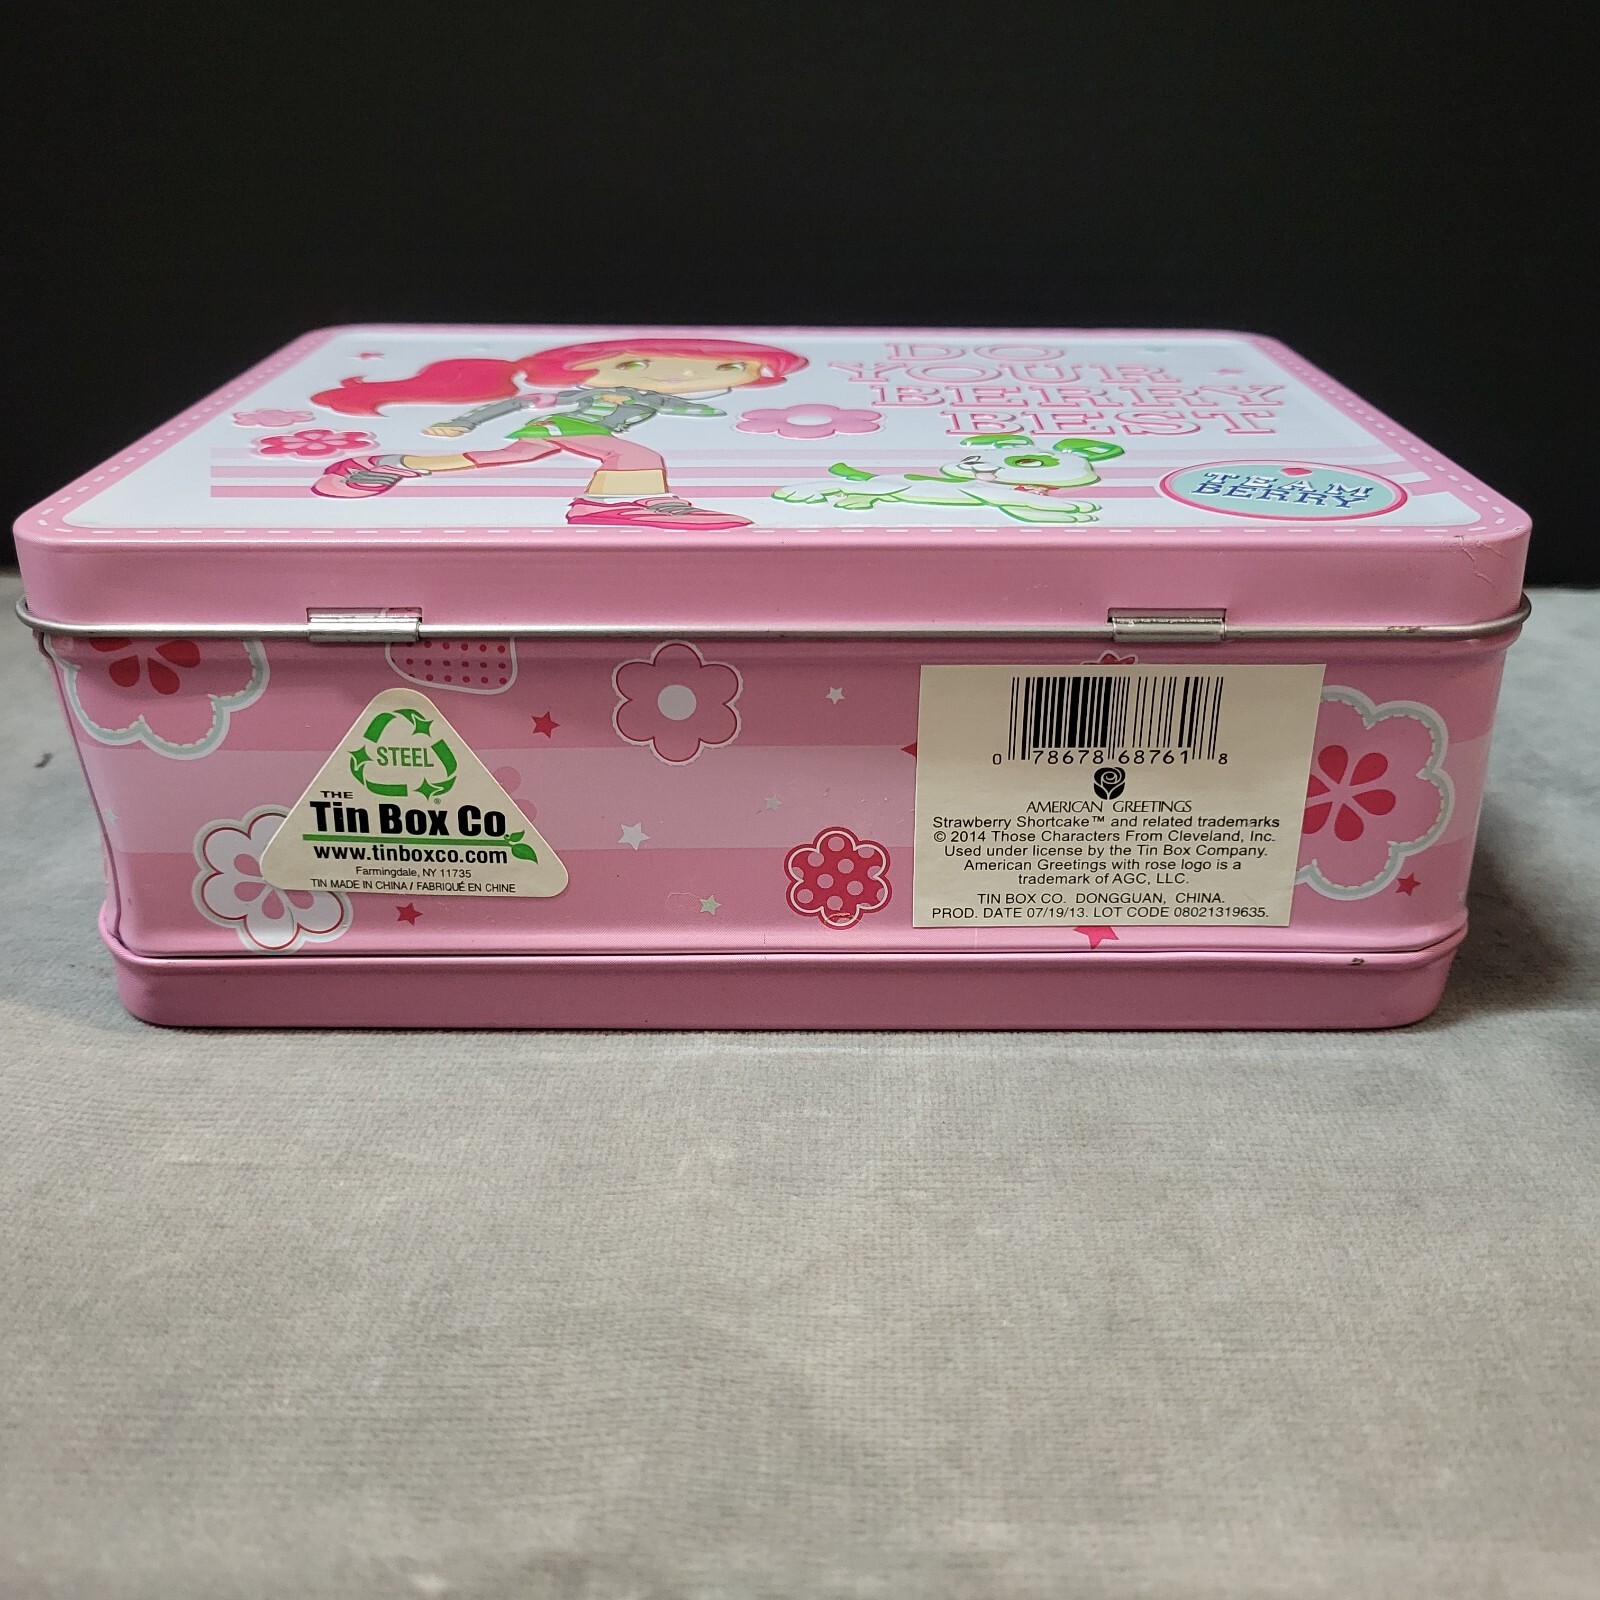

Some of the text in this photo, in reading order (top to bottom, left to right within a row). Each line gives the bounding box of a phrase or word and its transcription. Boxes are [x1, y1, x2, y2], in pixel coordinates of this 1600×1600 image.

[884, 343, 1067, 361] DO
[827, 362, 1182, 383] YOUR
[870, 385, 1286, 408] BERRY
[941, 410, 1278, 436] BEST
[1204, 472, 1374, 498] TEAM
[1191, 483, 1366, 508] BERRY
[376, 746, 434, 768] STEEL
[992, 749, 1228, 765] 0 78678 68761 8
[320, 790, 354, 799] THE
[1026, 800, 1193, 813] AMERICAN GREETINGS
[310, 801, 370, 834] Tin
[379, 803, 448, 837] Box
[933, 816, 1012, 830] Strawberry
[1110, 816, 1138, 828] and
[1142, 816, 1193, 828] related
[1198, 816, 1280, 828] trademarks
[950, 831, 987, 843] 2014
[991, 830, 1036, 843] Those
[1041, 830, 1120, 843] Characters
[1125, 830, 1163, 843] From
[1168, 830, 1244, 843] Cleveland,
[1250, 830, 1277, 843] Inc.
[313, 844, 508, 864] www.tinboxco.com
[944, 844, 1268, 858] Used under license by the Tin Box Company.
[356, 867, 472, 879] Farmingdale, NY 11735
[964, 859, 1241, 873] American Greetings with rose logo is a
[310, 878, 327, 889] TIN
[330, 879, 361, 890] MADE
[363, 880, 373, 890] IN
[375, 880, 408, 890] CHINA
[416, 881, 465, 893] FABRIQUÉ
[468, 882, 482, 893] EN
[485, 882, 516, 893] CHINE
[1018, 873, 1189, 886] trademark of AGC, LLC.
[977, 892, 1225, 906] TIN BOX CO. DONGGUAN, CHINA.
[932, 906, 1269, 919] PROD. DATE 07/19/13. LOT CODE 08021319635.
